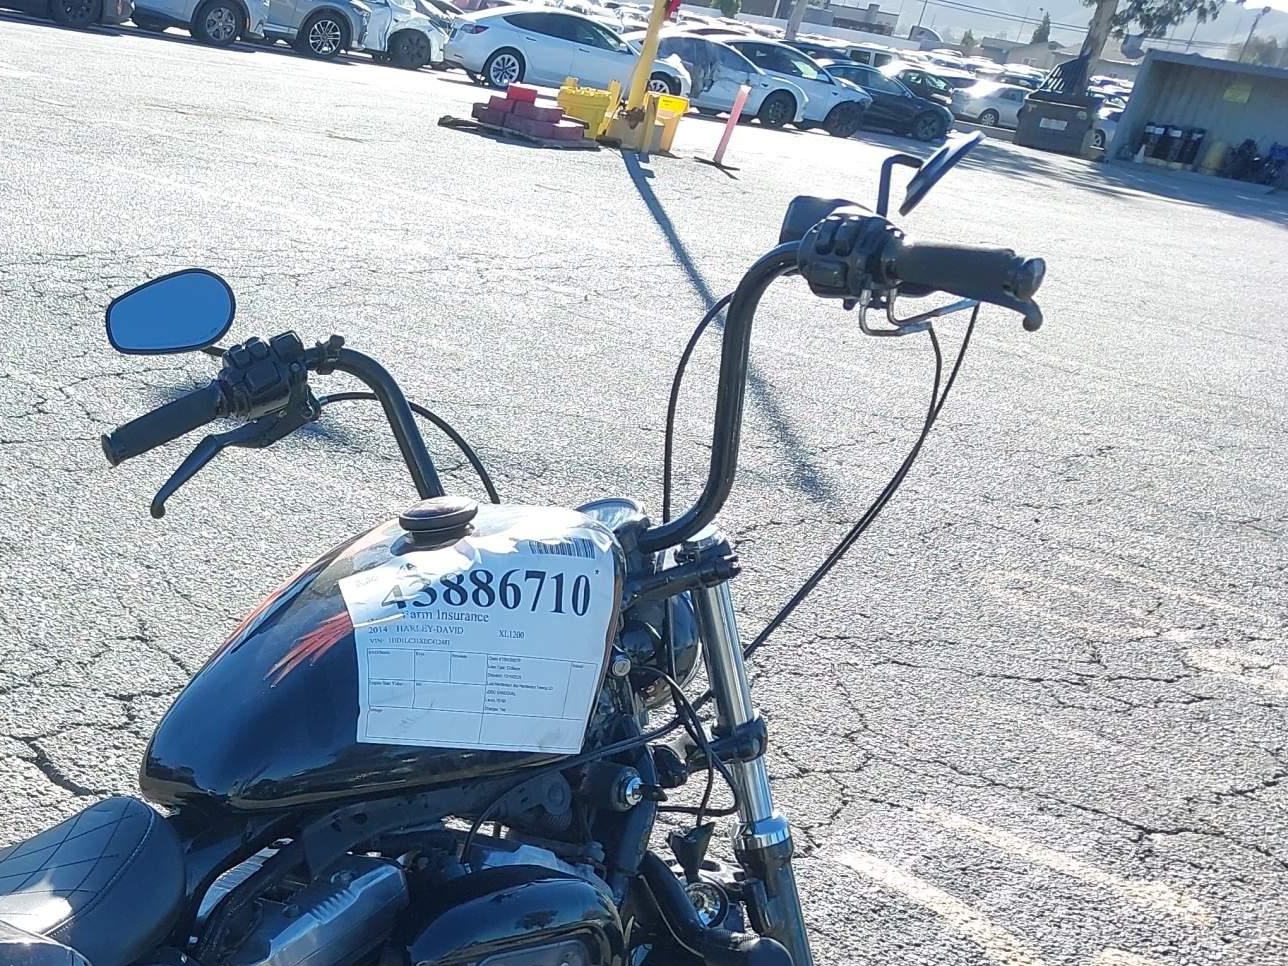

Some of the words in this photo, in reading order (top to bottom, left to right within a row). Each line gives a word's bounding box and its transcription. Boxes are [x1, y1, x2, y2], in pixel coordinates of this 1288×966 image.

[437, 609, 490, 623] Insurance
[368, 625, 388, 635] 2014
[396, 624, 464, 635] HARLEY-DAVID
[498, 629, 525, 640] XL1200
